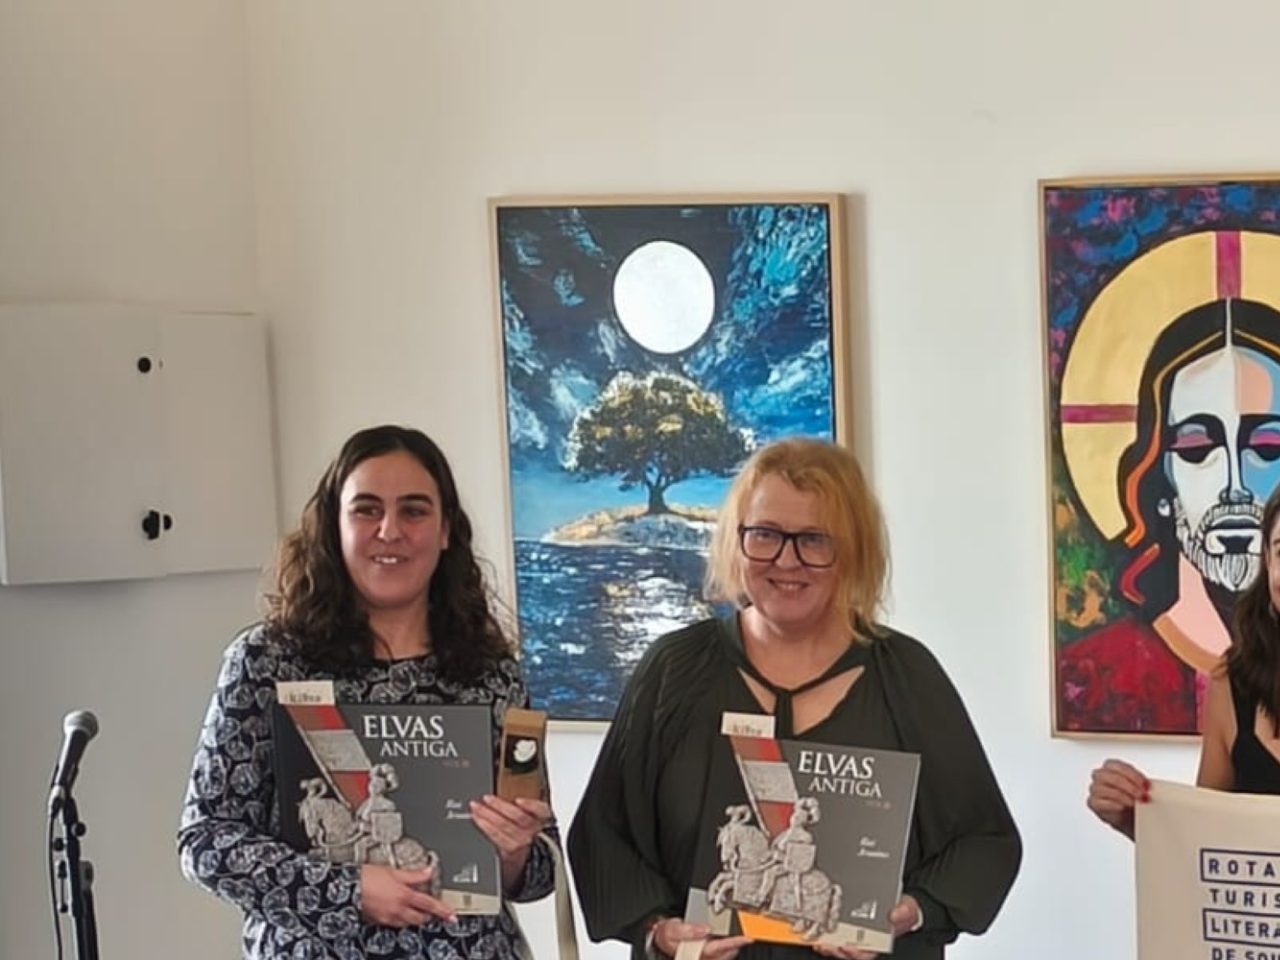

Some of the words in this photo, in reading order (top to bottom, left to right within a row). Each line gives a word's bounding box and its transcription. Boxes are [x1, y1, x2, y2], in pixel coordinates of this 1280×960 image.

[363, 715, 444, 738] ELVAS
[380, 741, 458, 758] ANTIGA
[798, 750, 875, 779] ELVAS
[808, 776, 882, 798] ANTIGA
[1208, 858, 1275, 878] ROTA
